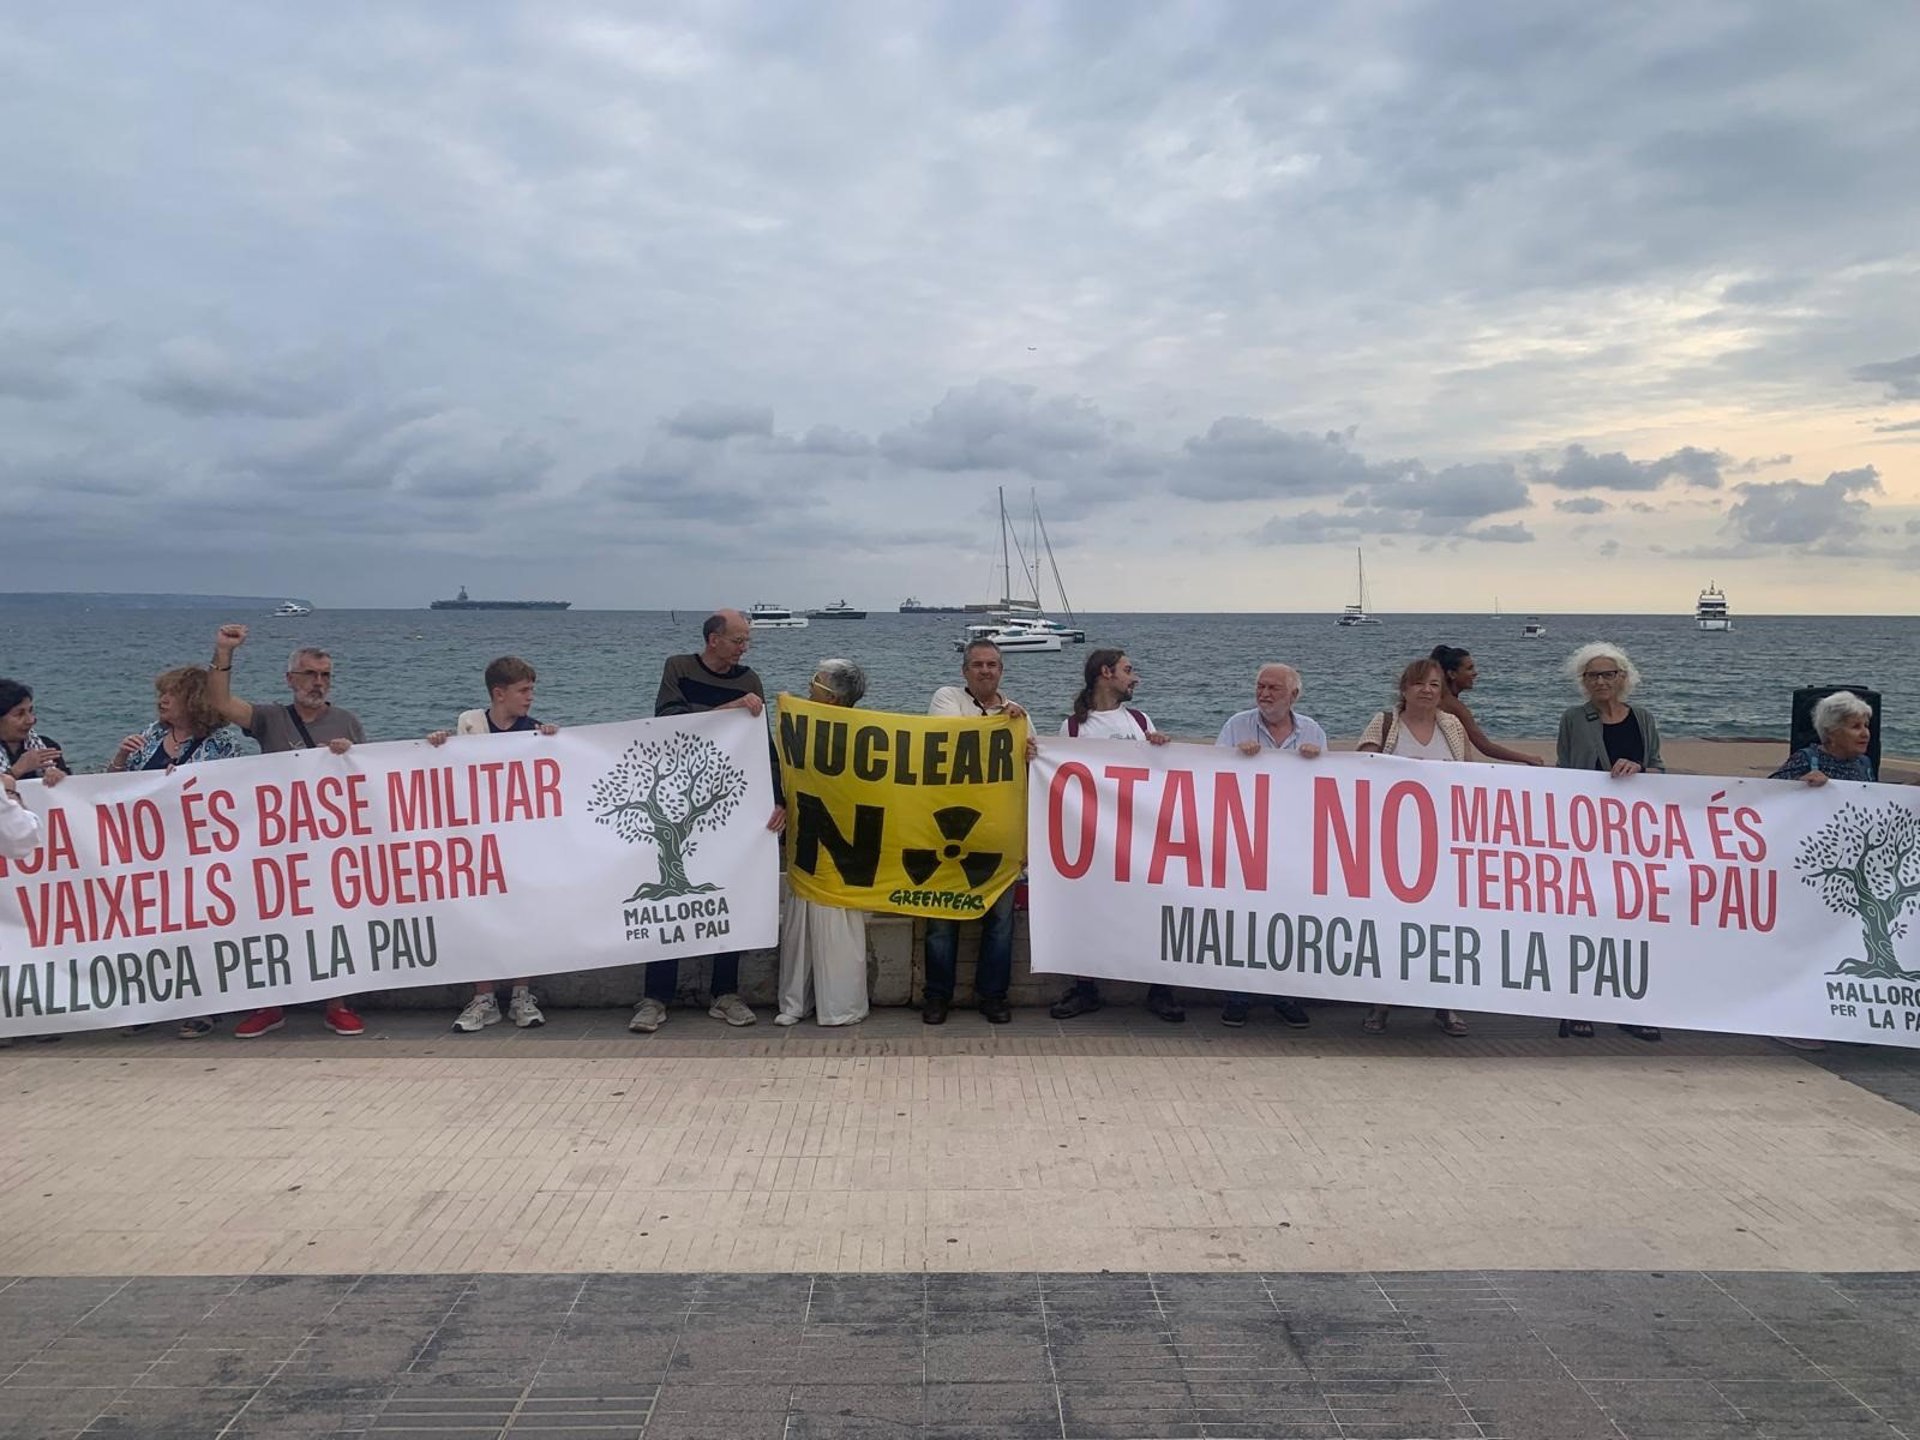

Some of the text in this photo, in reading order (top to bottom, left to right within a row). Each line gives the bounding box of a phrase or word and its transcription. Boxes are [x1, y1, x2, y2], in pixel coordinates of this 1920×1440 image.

[780, 711, 1014, 786] NUCLEAR
[96, 800, 165, 866] NO
[180, 776, 240, 856] ÉS
[255, 774, 373, 847] BASE
[387, 758, 563, 833] MILITAR
[1048, 761, 1439, 904] OTAN NO
[1450, 784, 1768, 863] MALLORCA ÉS
[16, 833, 508, 949] VAIXELLS DE GUERRA
[623, 897, 729, 927] MALLORCA
[1450, 847, 1777, 933] TERRA DE PAU
[214, 933, 292, 993] PER
[306, 924, 355, 982] LA
[367, 916, 438, 972] PAU
[626, 919, 730, 945] PER LA PAU
[1160, 905, 1649, 1001] MALLORCA PER LA PAU
[1830, 1004, 1857, 1018] PER
[1867, 1008, 1895, 1030] LA
